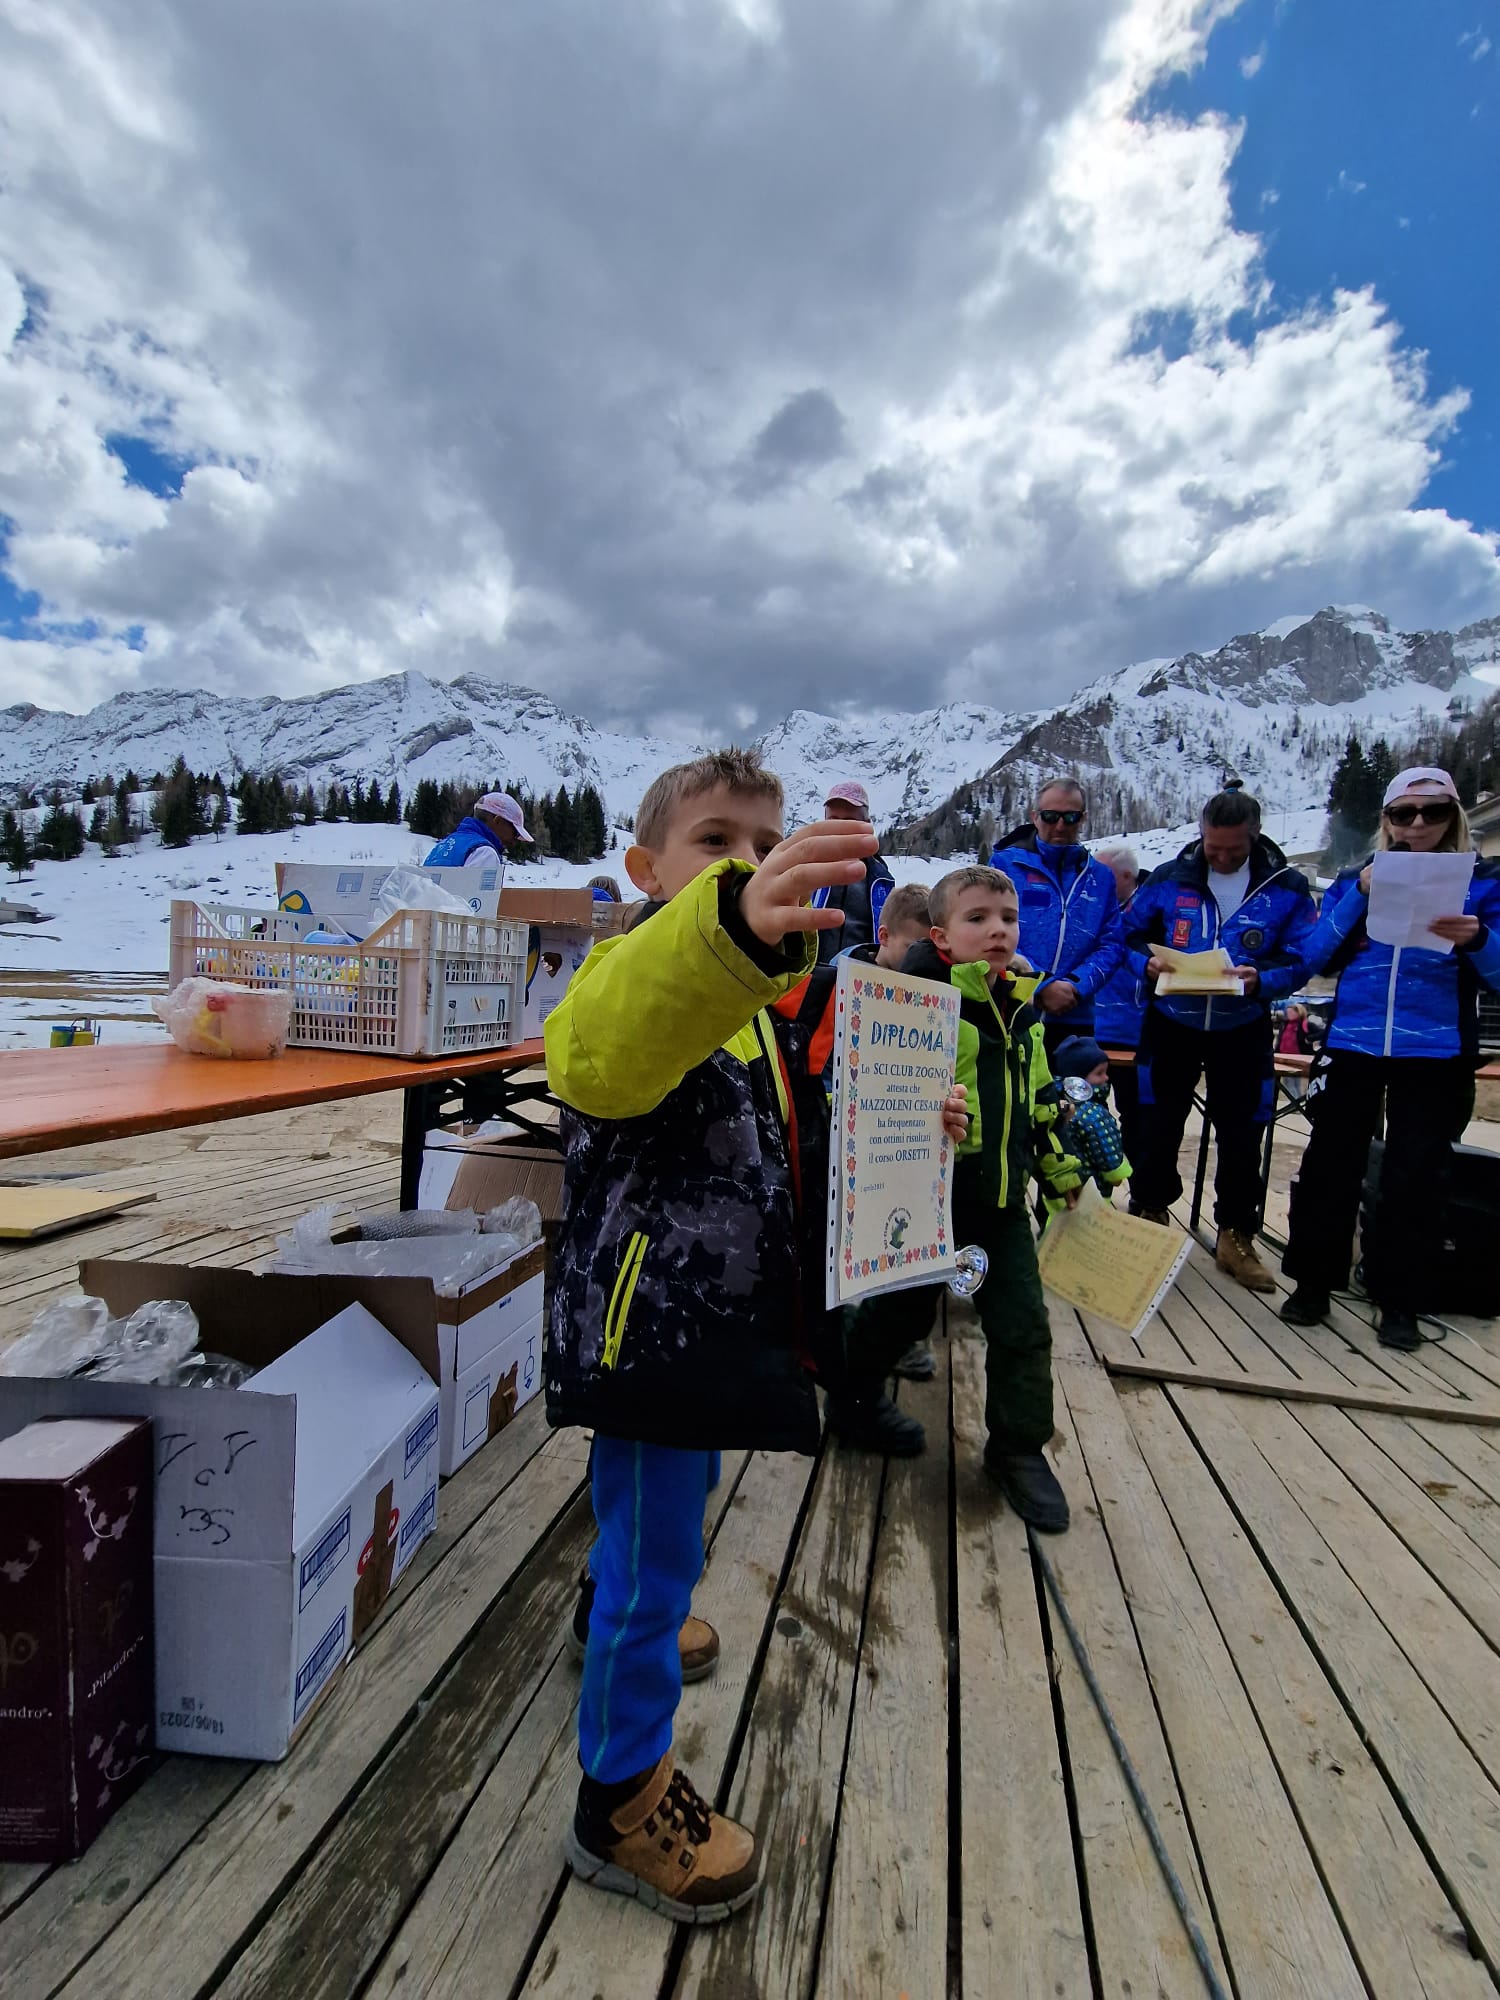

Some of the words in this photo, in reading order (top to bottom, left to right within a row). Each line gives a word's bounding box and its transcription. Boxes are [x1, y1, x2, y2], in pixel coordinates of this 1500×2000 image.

[871, 1021, 944, 1052] DIPLOMA
[861, 1064, 870, 1075] Lo
[873, 1062, 889, 1076] SCI
[890, 1064, 913, 1077] CLUB
[915, 1065, 948, 1079] ZOGNO
[886, 1083, 909, 1093] attesta
[909, 1082, 921, 1094] che
[860, 1099, 912, 1111] MAZZOLENI
[914, 1099, 944, 1112] CESARE
[877, 1117, 887, 1128] ha
[887, 1116, 926, 1131] frequentato
[869, 1136, 882, 1145] con
[883, 1132, 905, 1144] ottimi
[906, 1132, 931, 1143] risultati
[868, 1152, 874, 1164] il
[875, 1155, 894, 1163] corso
[895, 1148, 930, 1162] ORSETTI
